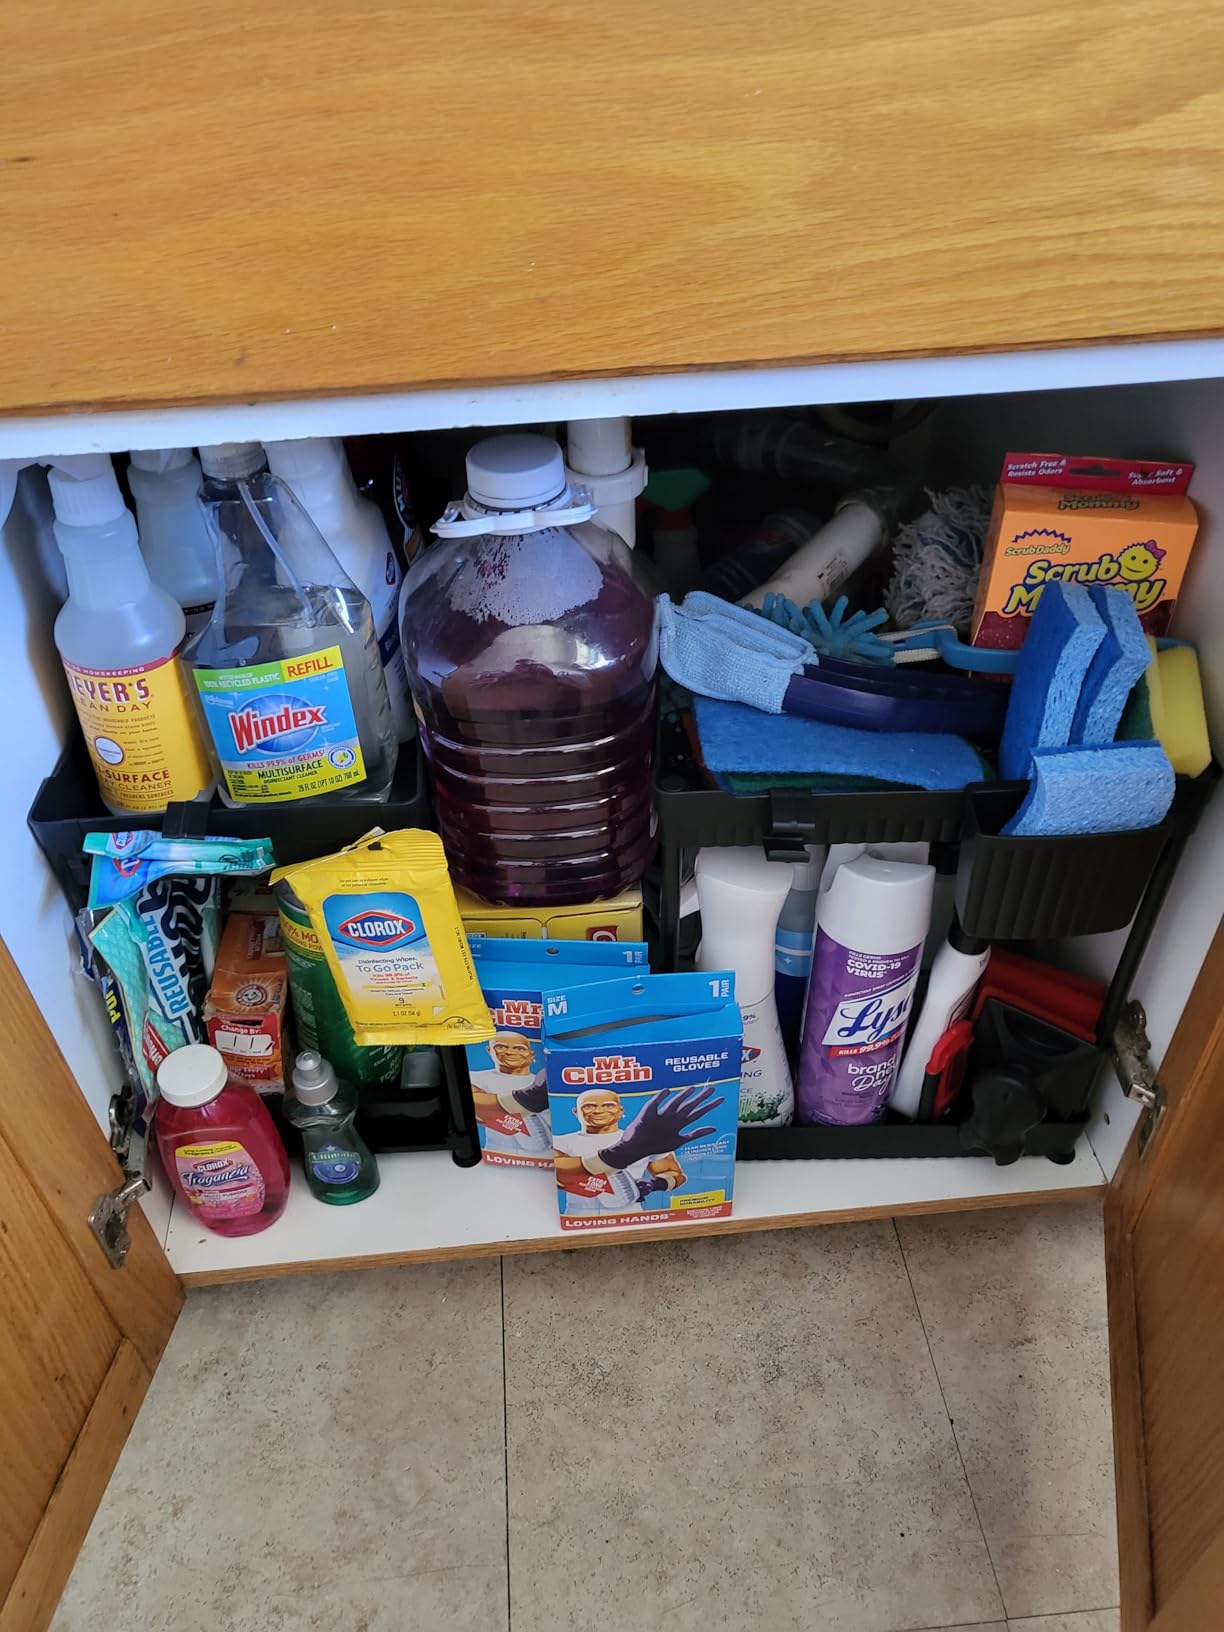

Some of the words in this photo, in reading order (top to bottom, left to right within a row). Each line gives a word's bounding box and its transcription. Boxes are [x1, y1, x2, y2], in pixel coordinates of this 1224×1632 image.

[1007, 462, 1037, 471] Scratch
[1039, 460, 1058, 468] Free
[1007, 469, 1036, 477] Resists
[1038, 467, 1063, 475] Odors
[1154, 469, 1174, 477] Soft
[1131, 476, 1176, 486] Absorbent
[1024, 552, 1122, 586] Scrub
[287, 656, 333, 678] REFILL
[219, 678, 252, 688] RECYCLED
[252, 672, 281, 685] PLASTIC
[116, 700, 152, 713] DAY
[229, 704, 328, 754] Windex
[257, 760, 324, 780] MULTISURFACE
[263, 775, 295, 784] DISINFECTANT
[296, 770, 318, 780] CLEANER
[118, 780, 172, 791] CLEANER
[347, 919, 406, 938] CLOROX
[622, 950, 633, 963] 1
[355, 964, 371, 973] To
[373, 964, 391, 973] Go
[393, 961, 424, 972] Pack
[847, 959, 902, 971] COVID-19
[708, 979, 720, 998] 1
[720, 979, 730, 998] PAIR
[547, 994, 567, 1004] SIZE
[548, 1000, 568, 1017] M
[221, 1024, 249, 1034] Change
[593, 1055, 641, 1071] Mr.
[665, 1051, 729, 1066] REUSABLE
[847, 1053, 897, 1075] brand
[673, 1060, 721, 1073] GLOVES
[561, 1065, 653, 1085] Clean
[851, 1074, 892, 1096] Day
[196, 1158, 230, 1173] CLOROX
[486, 1154, 535, 1168] LOVING
[182, 1166, 250, 1188] Fraganzia
[565, 1218, 617, 1228] LOVING
